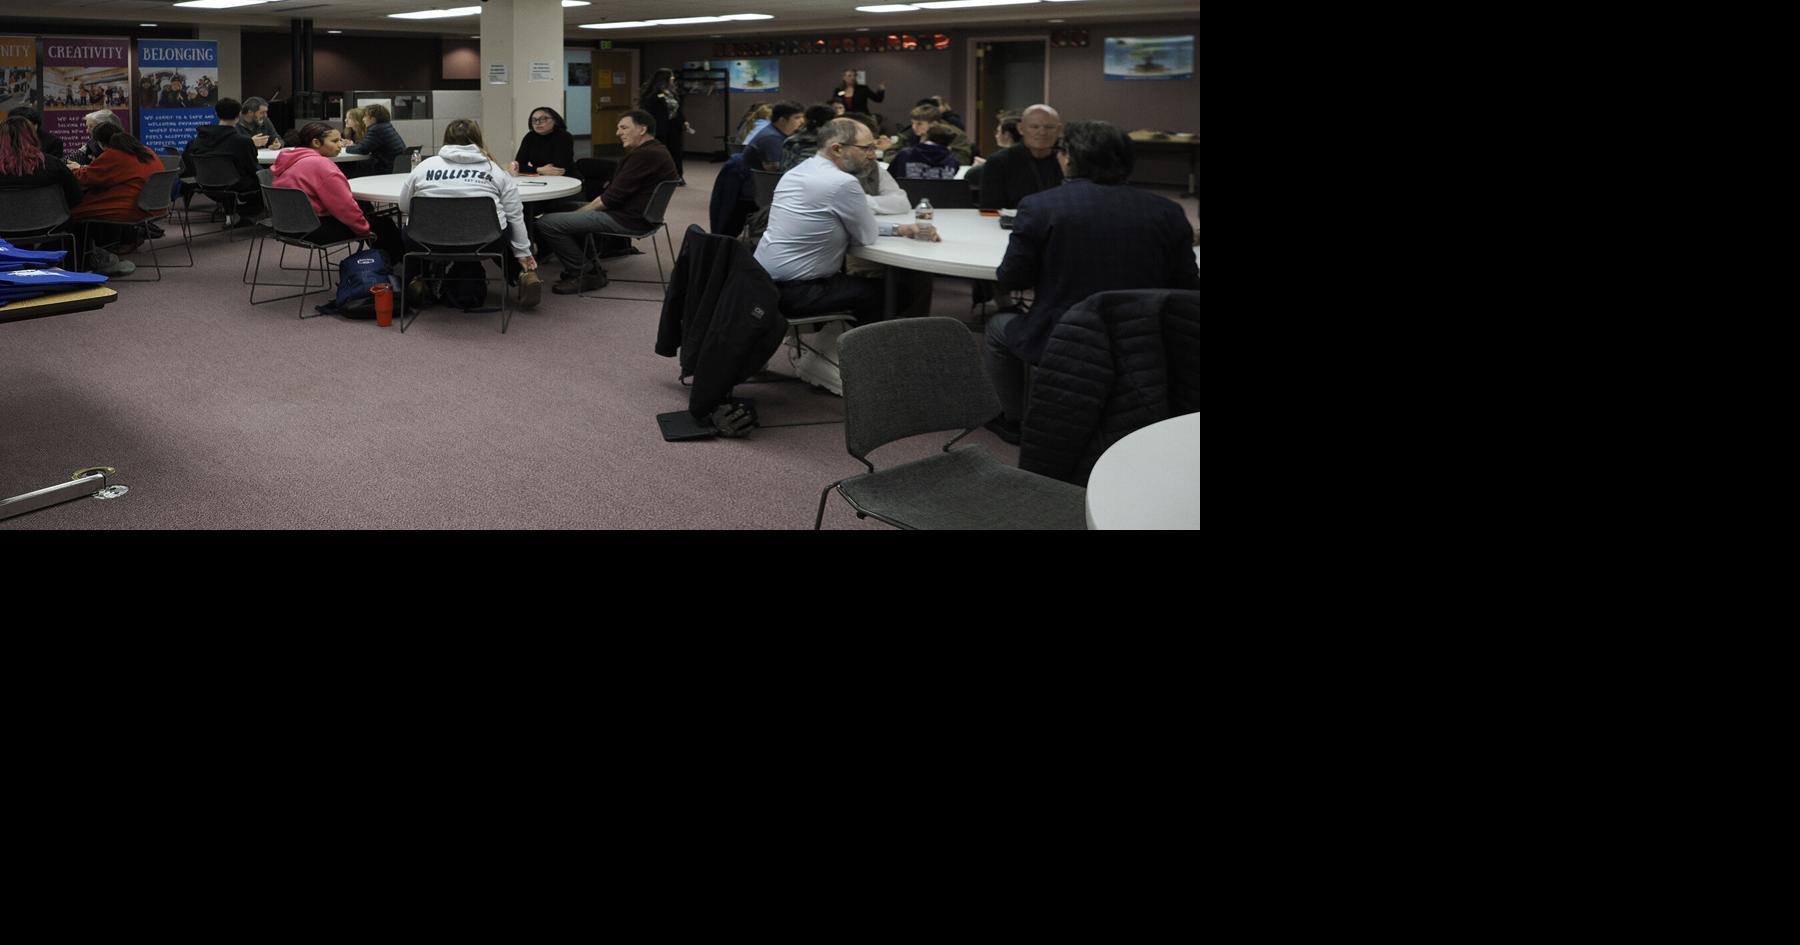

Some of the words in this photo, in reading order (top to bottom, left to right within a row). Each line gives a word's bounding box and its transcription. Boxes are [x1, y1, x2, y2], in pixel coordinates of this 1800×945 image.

[47, 45, 123, 60] CREATIVITY
[143, 47, 214, 61] BELONGING
[425, 169, 494, 182] HOLLISTER
